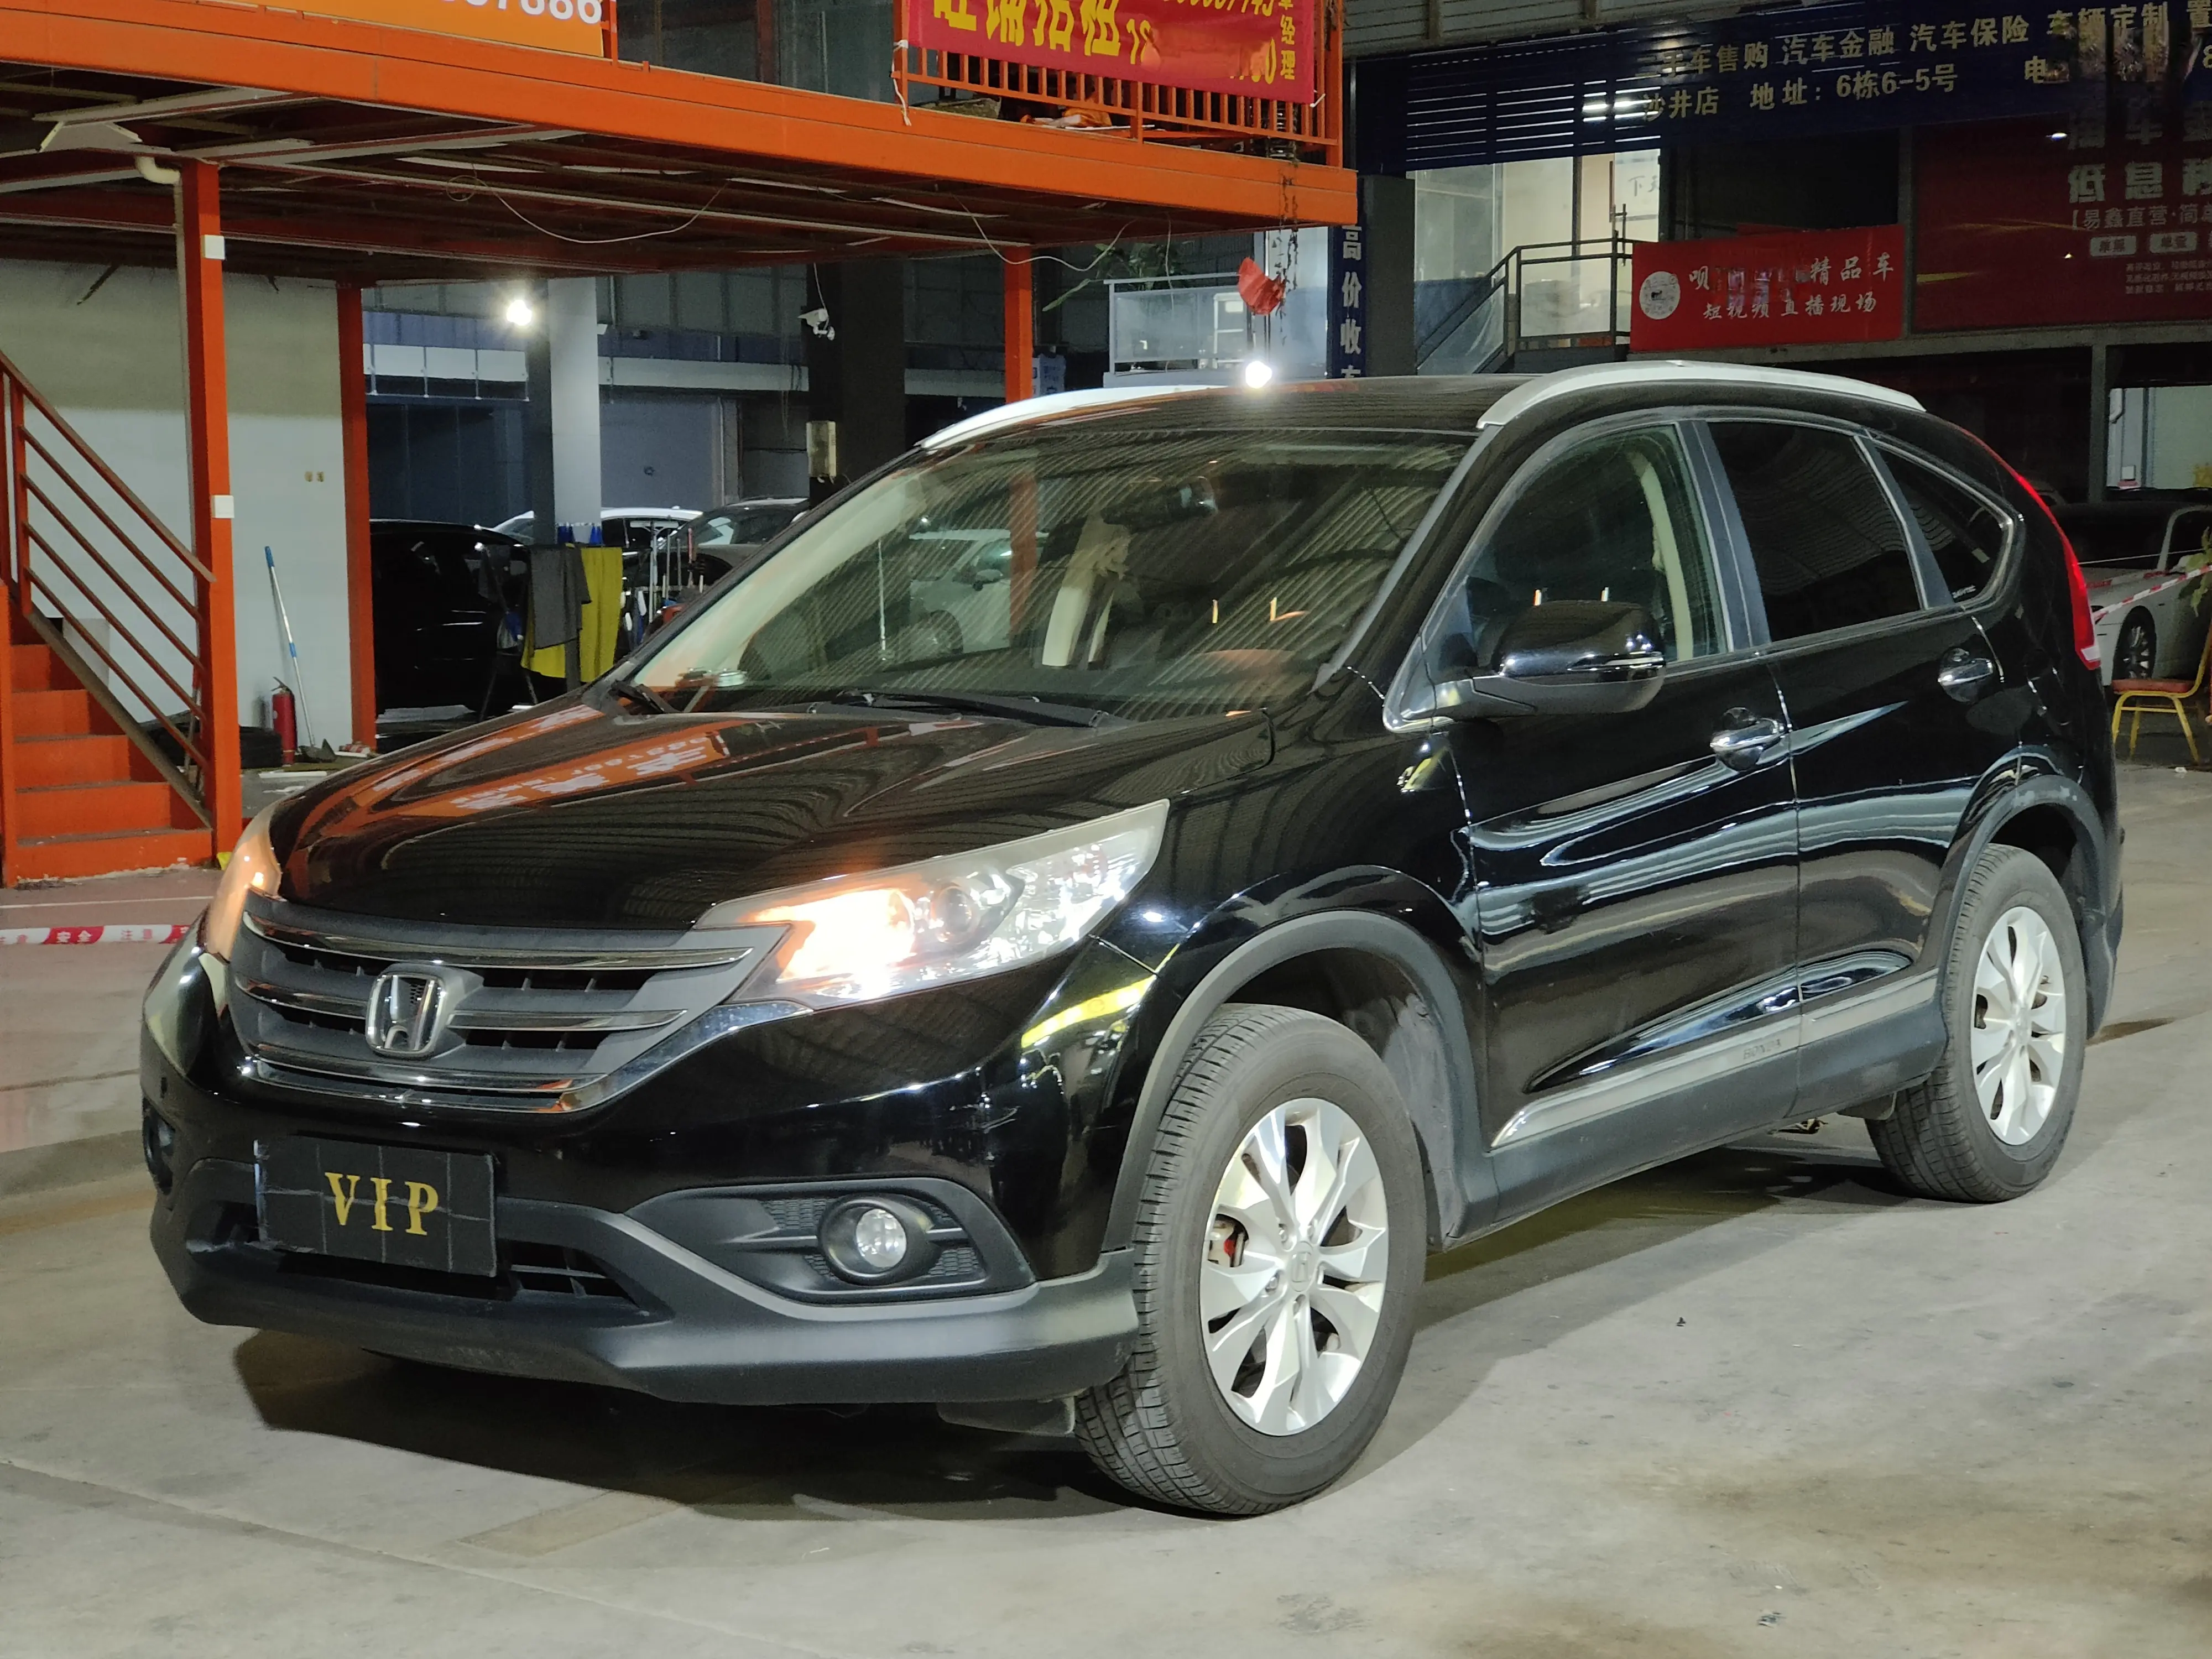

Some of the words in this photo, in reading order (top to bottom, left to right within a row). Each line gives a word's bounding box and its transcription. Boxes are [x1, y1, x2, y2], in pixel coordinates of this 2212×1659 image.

[1781, 26, 1895, 65] 汽车金融
[1910, 14, 2030, 53] 汽车保险
[324, 1172, 439, 1236] VIP
